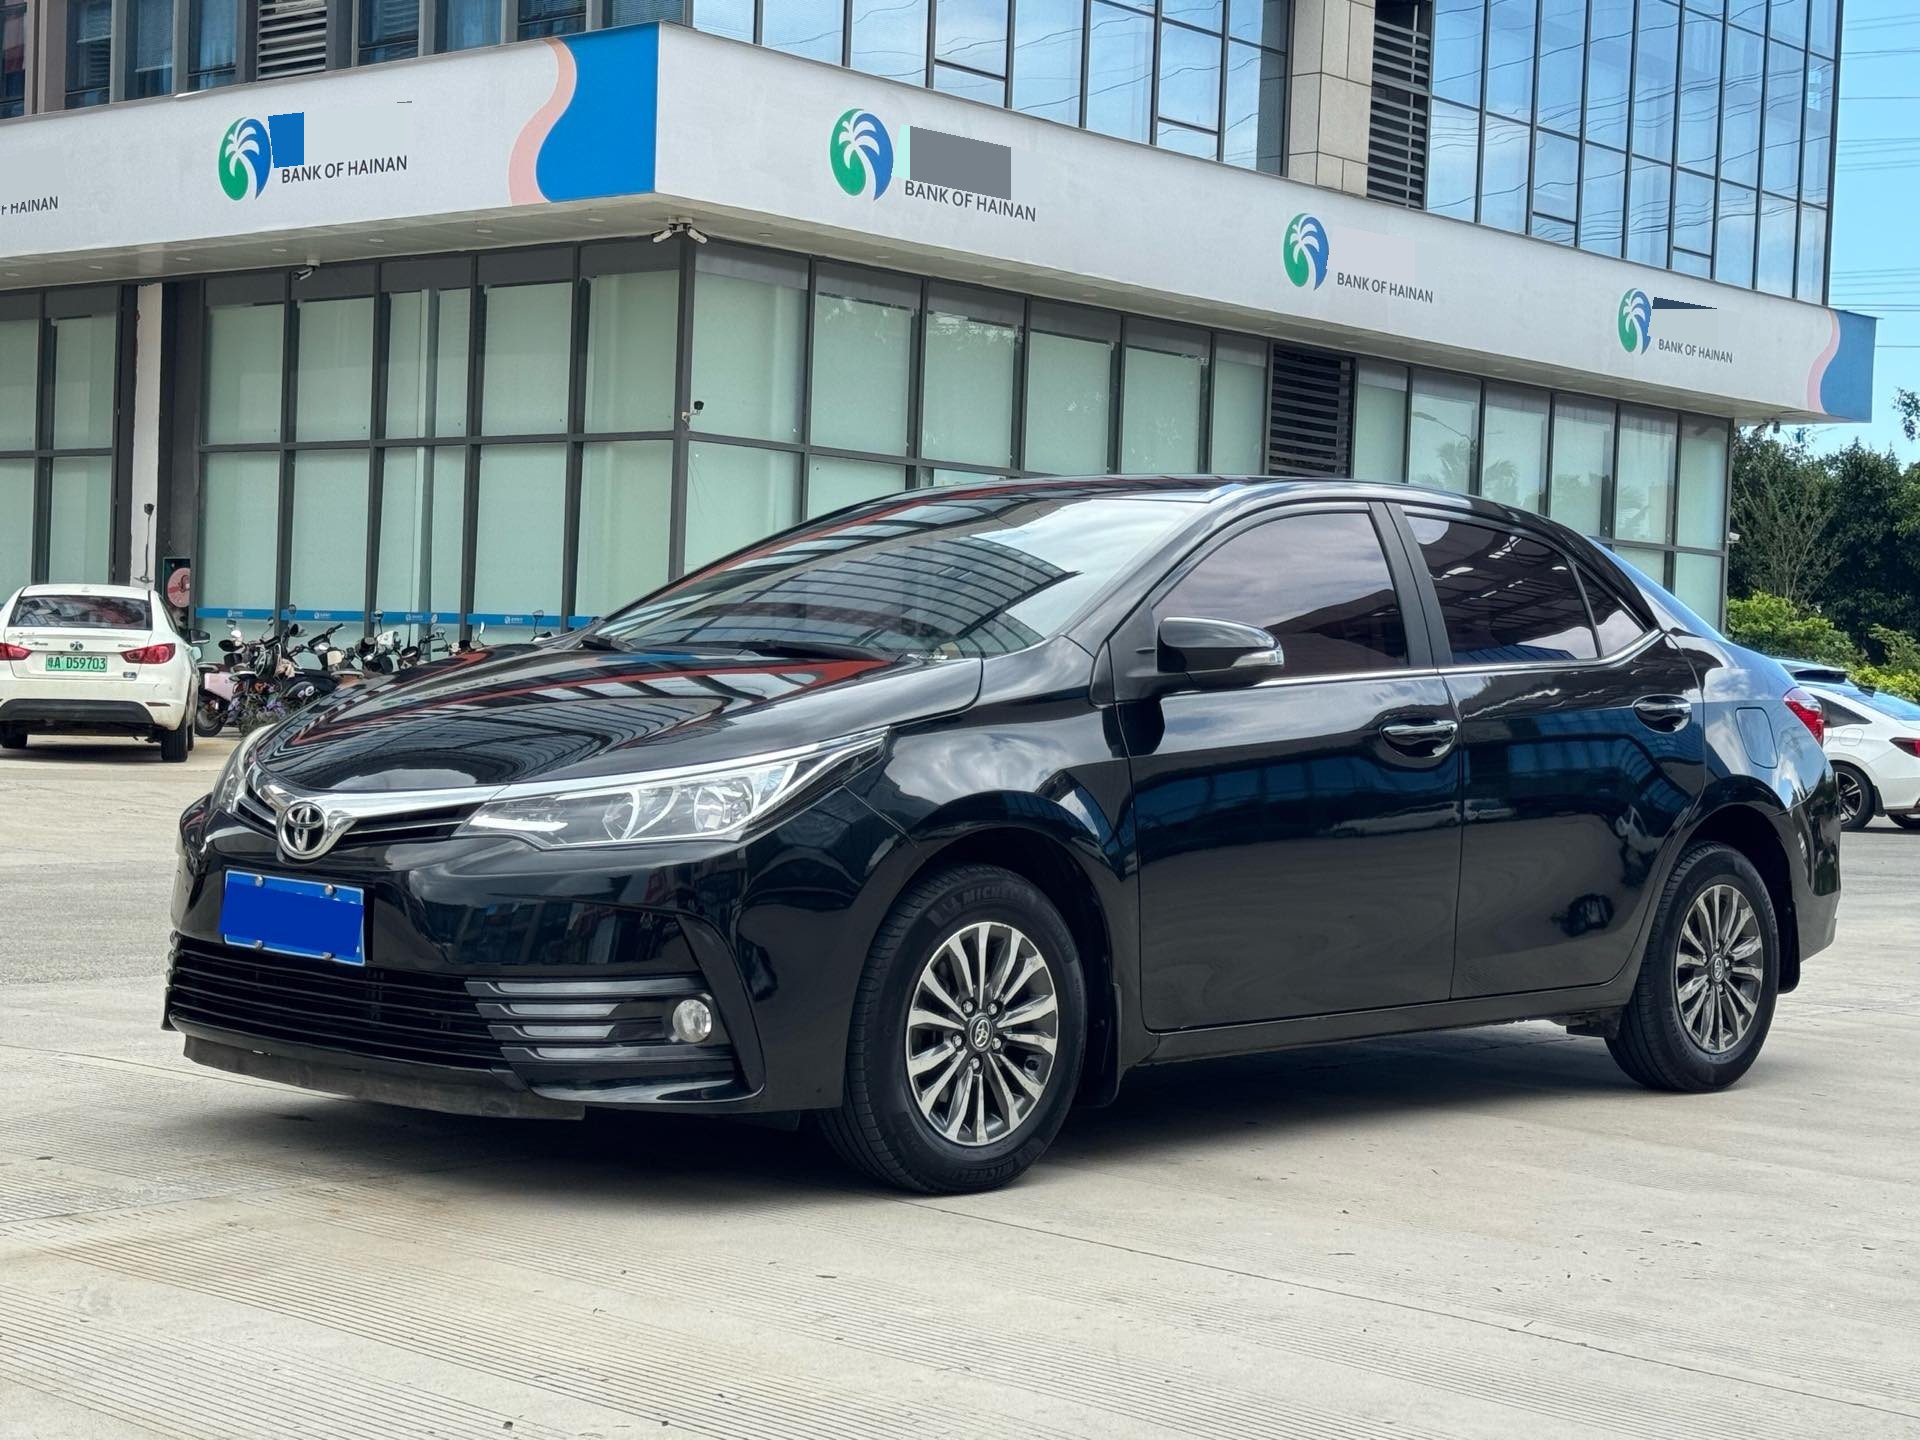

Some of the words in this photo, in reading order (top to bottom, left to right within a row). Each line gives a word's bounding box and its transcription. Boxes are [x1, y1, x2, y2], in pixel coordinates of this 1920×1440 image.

[281, 165, 322, 184] BANK
[324, 161, 344, 179] OF
[347, 155, 408, 176] HAINAN
[10, 195, 59, 215] HAINAN
[904, 180, 949, 204] BANK
[952, 191, 974, 208] OF
[976, 196, 1036, 222] HAINAN
[1337, 272, 1370, 293] BANK
[1371, 279, 1387, 294] OF
[1389, 283, 1434, 303] HAINAN
[1658, 339, 1683, 355] BANK
[1684, 343, 1697, 357] OF
[1698, 346, 1733, 364] HAINAN
[66, 656, 106, 670] D59703
